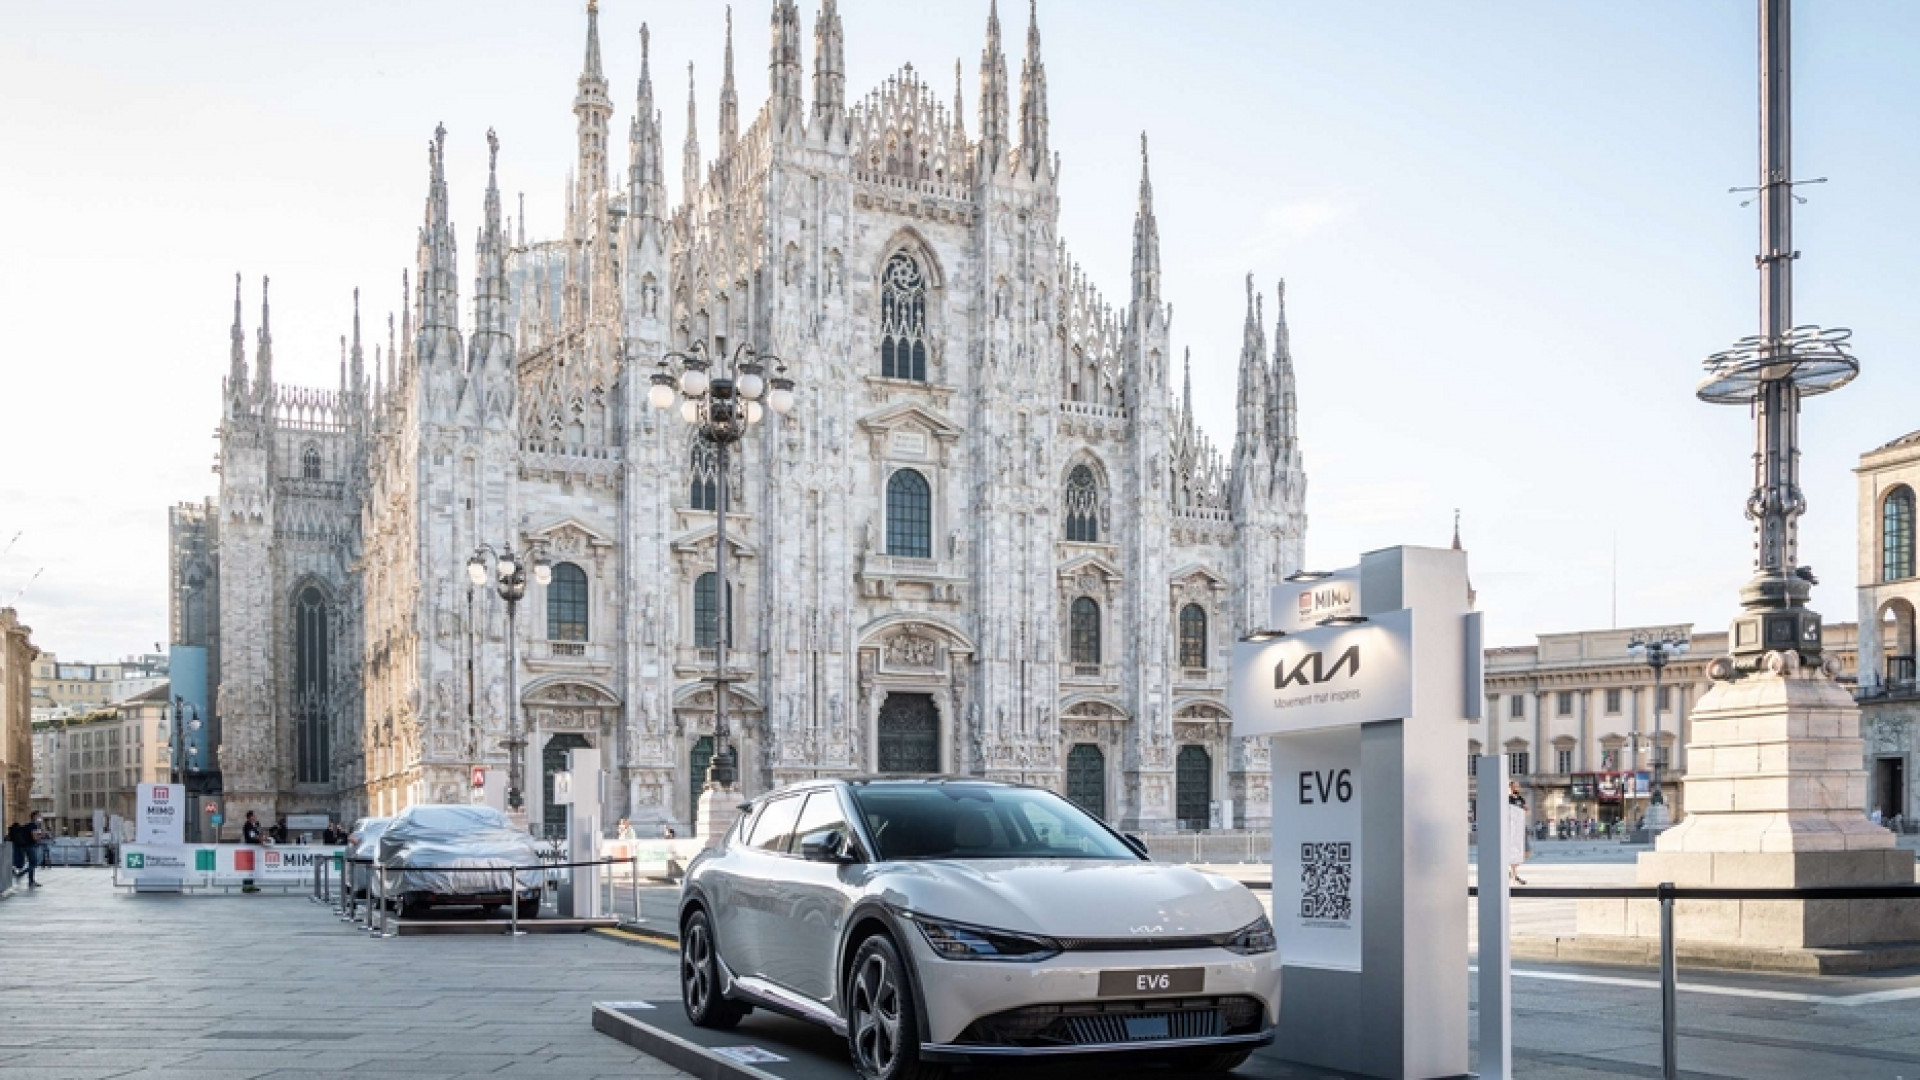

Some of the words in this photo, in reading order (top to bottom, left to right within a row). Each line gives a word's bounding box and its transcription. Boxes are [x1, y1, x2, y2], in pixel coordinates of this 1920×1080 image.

[1274, 645, 1360, 689] KIA
[1273, 695, 1312, 709] Movement
[1330, 688, 1361, 702] inspires
[1299, 768, 1353, 804] EV6
[146, 806, 175, 815] MIMO
[1136, 974, 1170, 990] EV6
